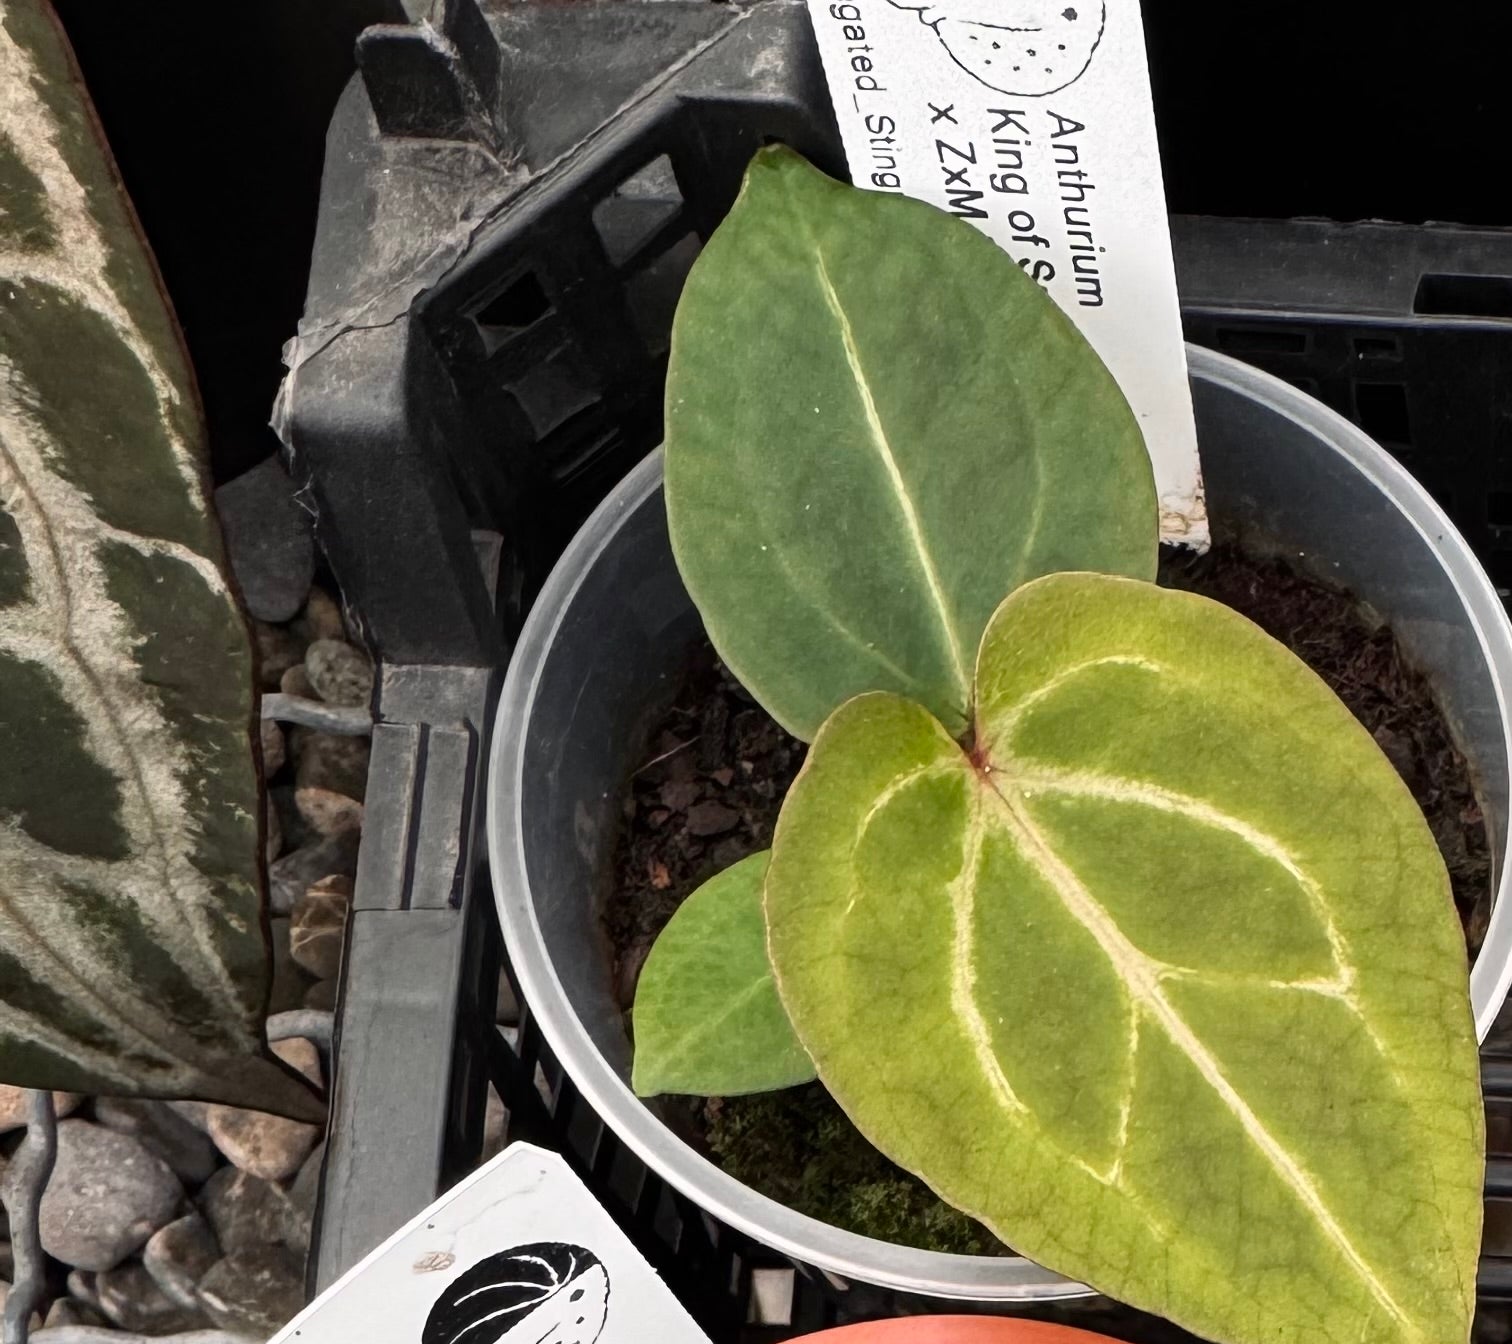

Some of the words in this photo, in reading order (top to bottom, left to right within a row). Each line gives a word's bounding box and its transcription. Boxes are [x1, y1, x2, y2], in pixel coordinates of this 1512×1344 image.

[829, 0, 903, 188] gated_Sting
[928, 102, 959, 125] x
[936, 139, 989, 220] ZxM
[987, 108, 1031, 195] King
[1007, 211, 1050, 248] of
[1047, 110, 1106, 307] Anthurium
